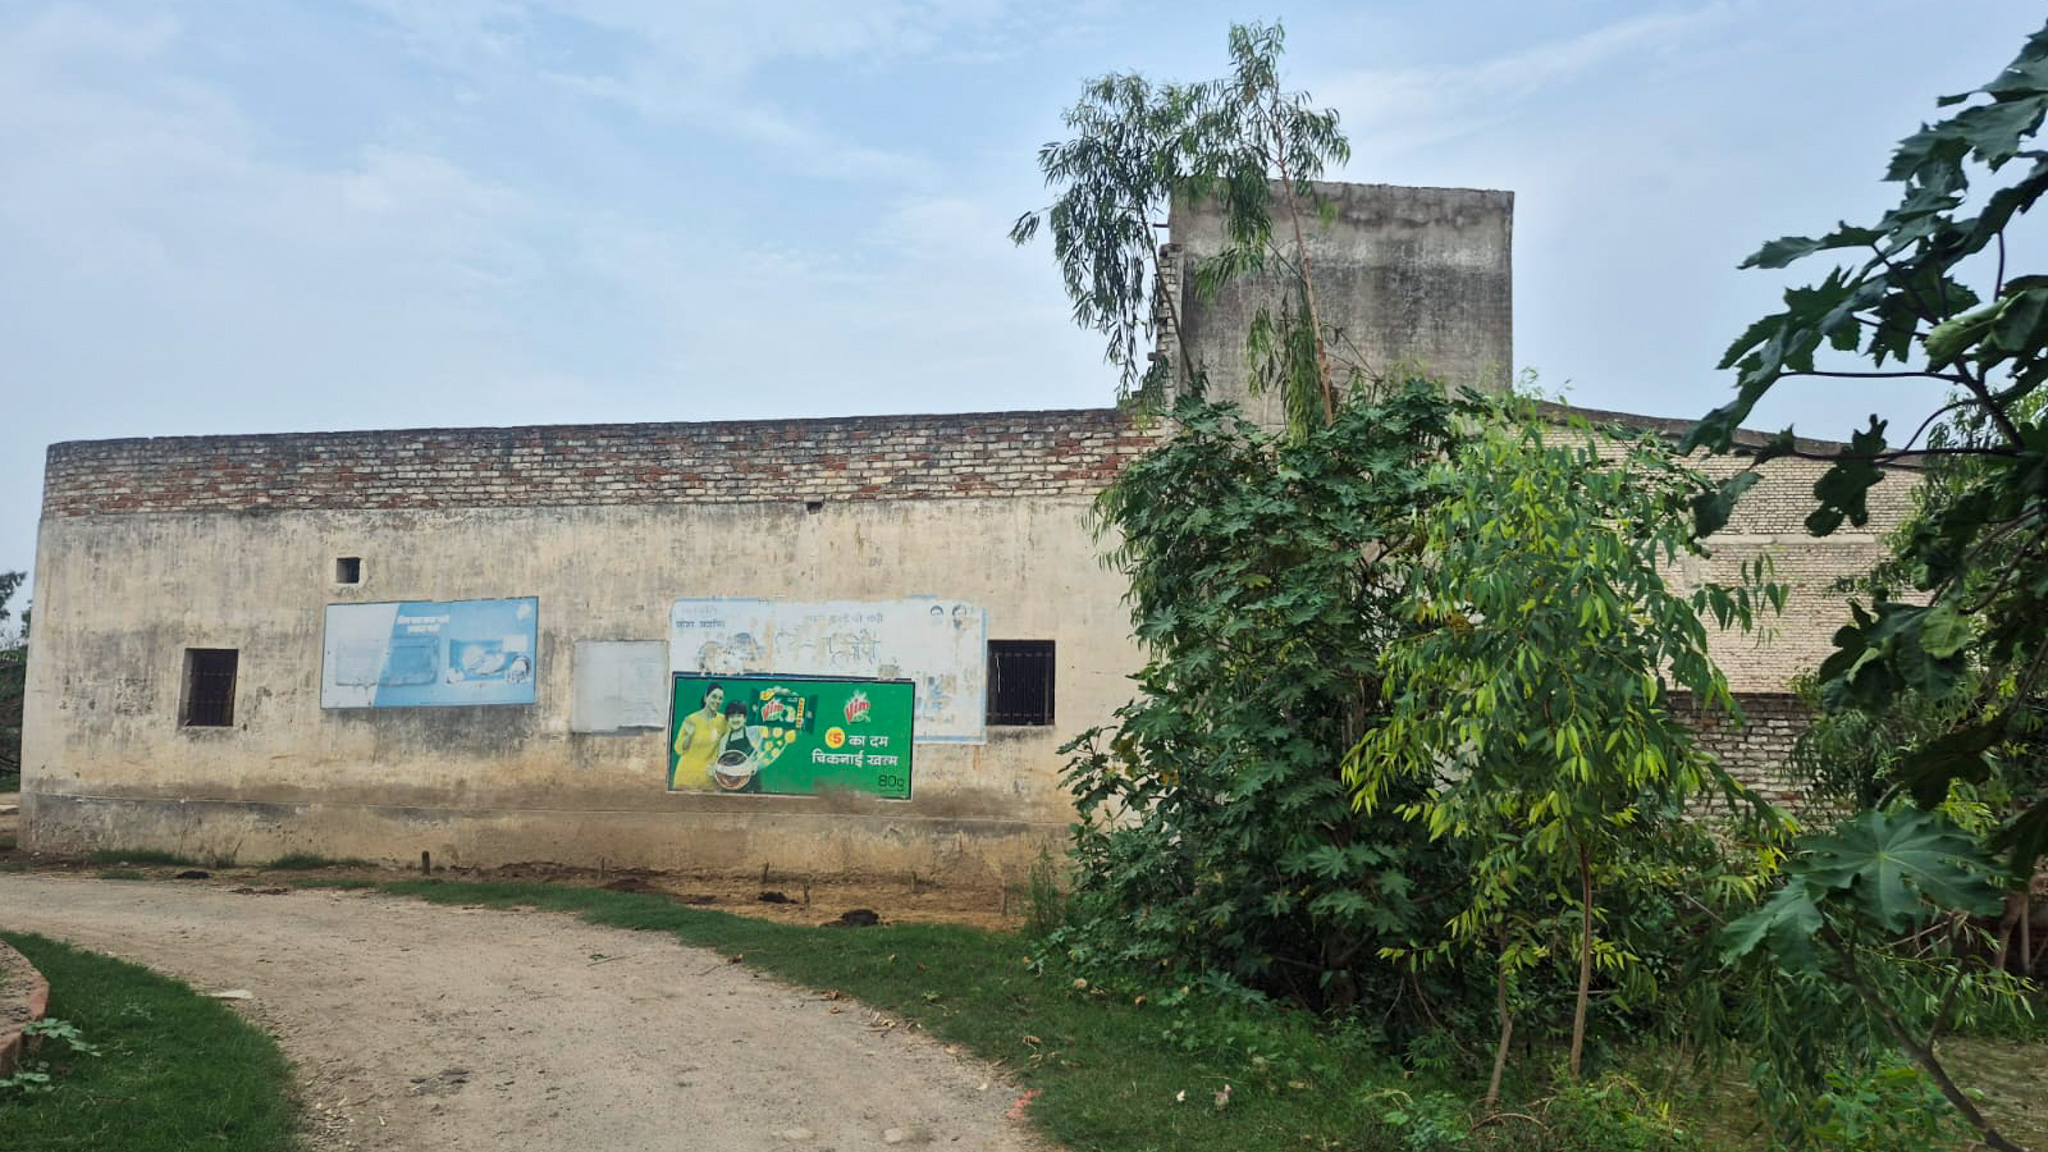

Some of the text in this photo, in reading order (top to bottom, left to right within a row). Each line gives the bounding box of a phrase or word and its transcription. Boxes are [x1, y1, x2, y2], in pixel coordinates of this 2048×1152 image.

[762, 704, 784, 722] Vim
[845, 699, 870, 723] Vim
[848, 735, 866, 747] का
[869, 735, 889, 748] दम
[812, 748, 899, 768] चिकनाई खत्म
[878, 774, 905, 792] 80g
